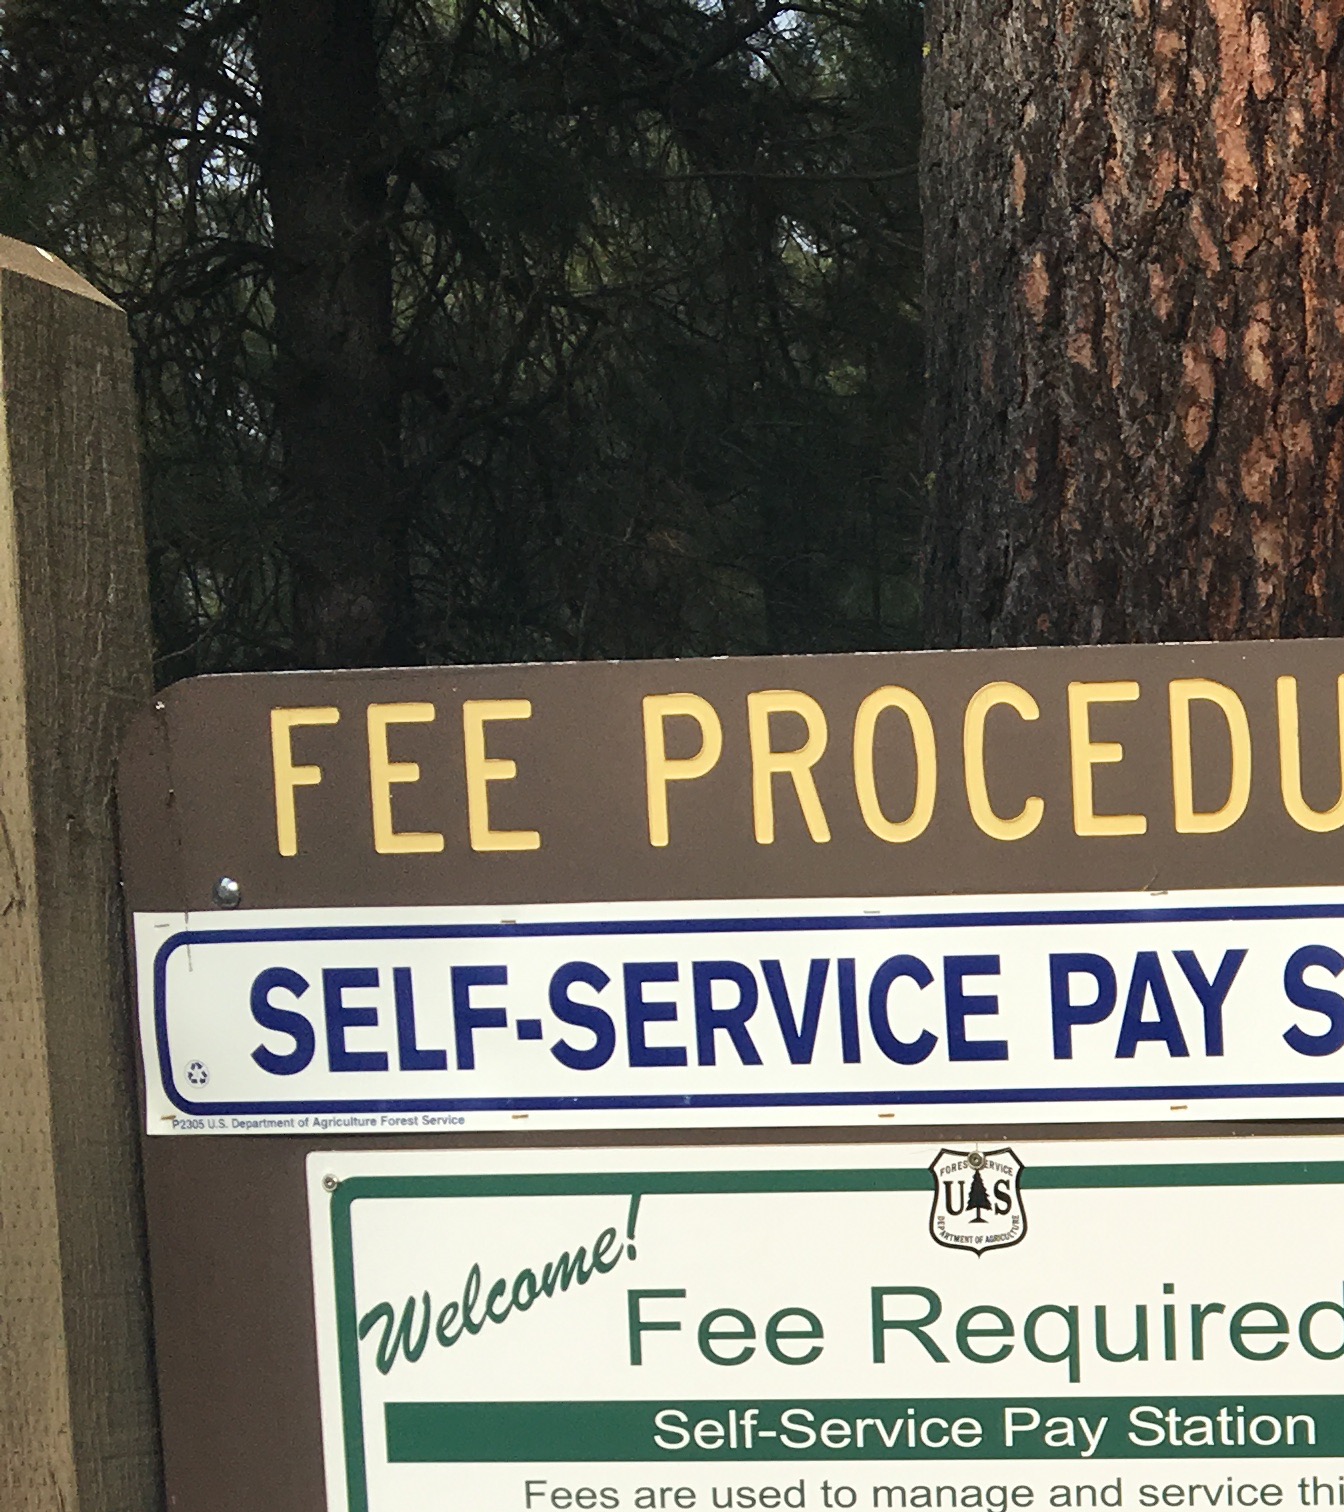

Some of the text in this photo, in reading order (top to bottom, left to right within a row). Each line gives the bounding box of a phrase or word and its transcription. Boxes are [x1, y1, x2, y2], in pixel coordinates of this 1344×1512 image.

[270, 699, 542, 857] FEE
[250, 953, 1008, 1077] SELF-SERVICE
[1049, 949, 1248, 1060] PAY
[171, 1114, 465, 1131] P2305 U.S. Department of Agriculture Forest Service
[358, 1195, 641, 1374] Welcome!
[626, 1288, 825, 1367] Fee
[653, 1405, 1316, 1458] Self-Service Pay Station
